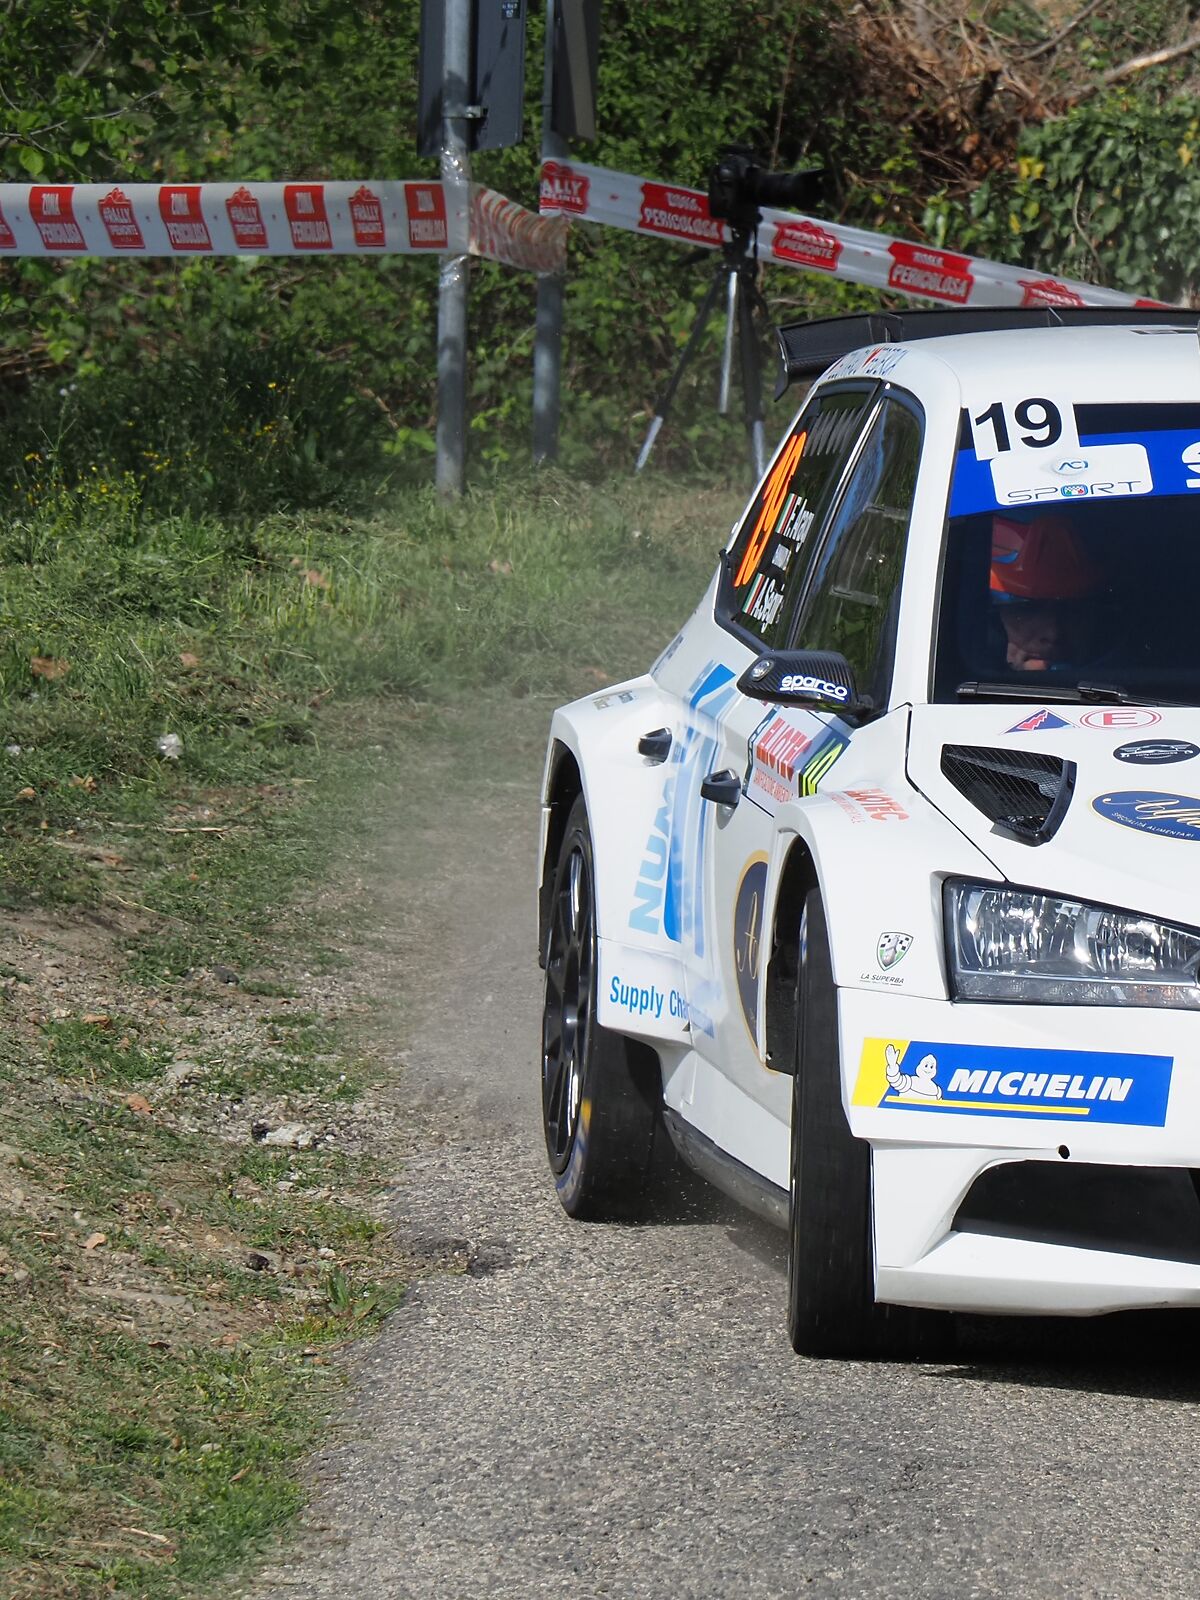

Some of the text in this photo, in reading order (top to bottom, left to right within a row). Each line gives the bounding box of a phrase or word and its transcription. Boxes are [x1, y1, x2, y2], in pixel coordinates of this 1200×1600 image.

[644, 208, 719, 239] PERICOLOSA
[893, 265, 968, 297] PERICOLOSA
[975, 397, 1062, 452] 19
[1008, 480, 1142, 504] SPORT
[781, 674, 848, 699] sparco
[860, 973, 869, 982] LA
[871, 974, 905, 985] SUPERBA
[609, 976, 664, 1019] Supply
[947, 1068, 1133, 1102] MICHELIN
